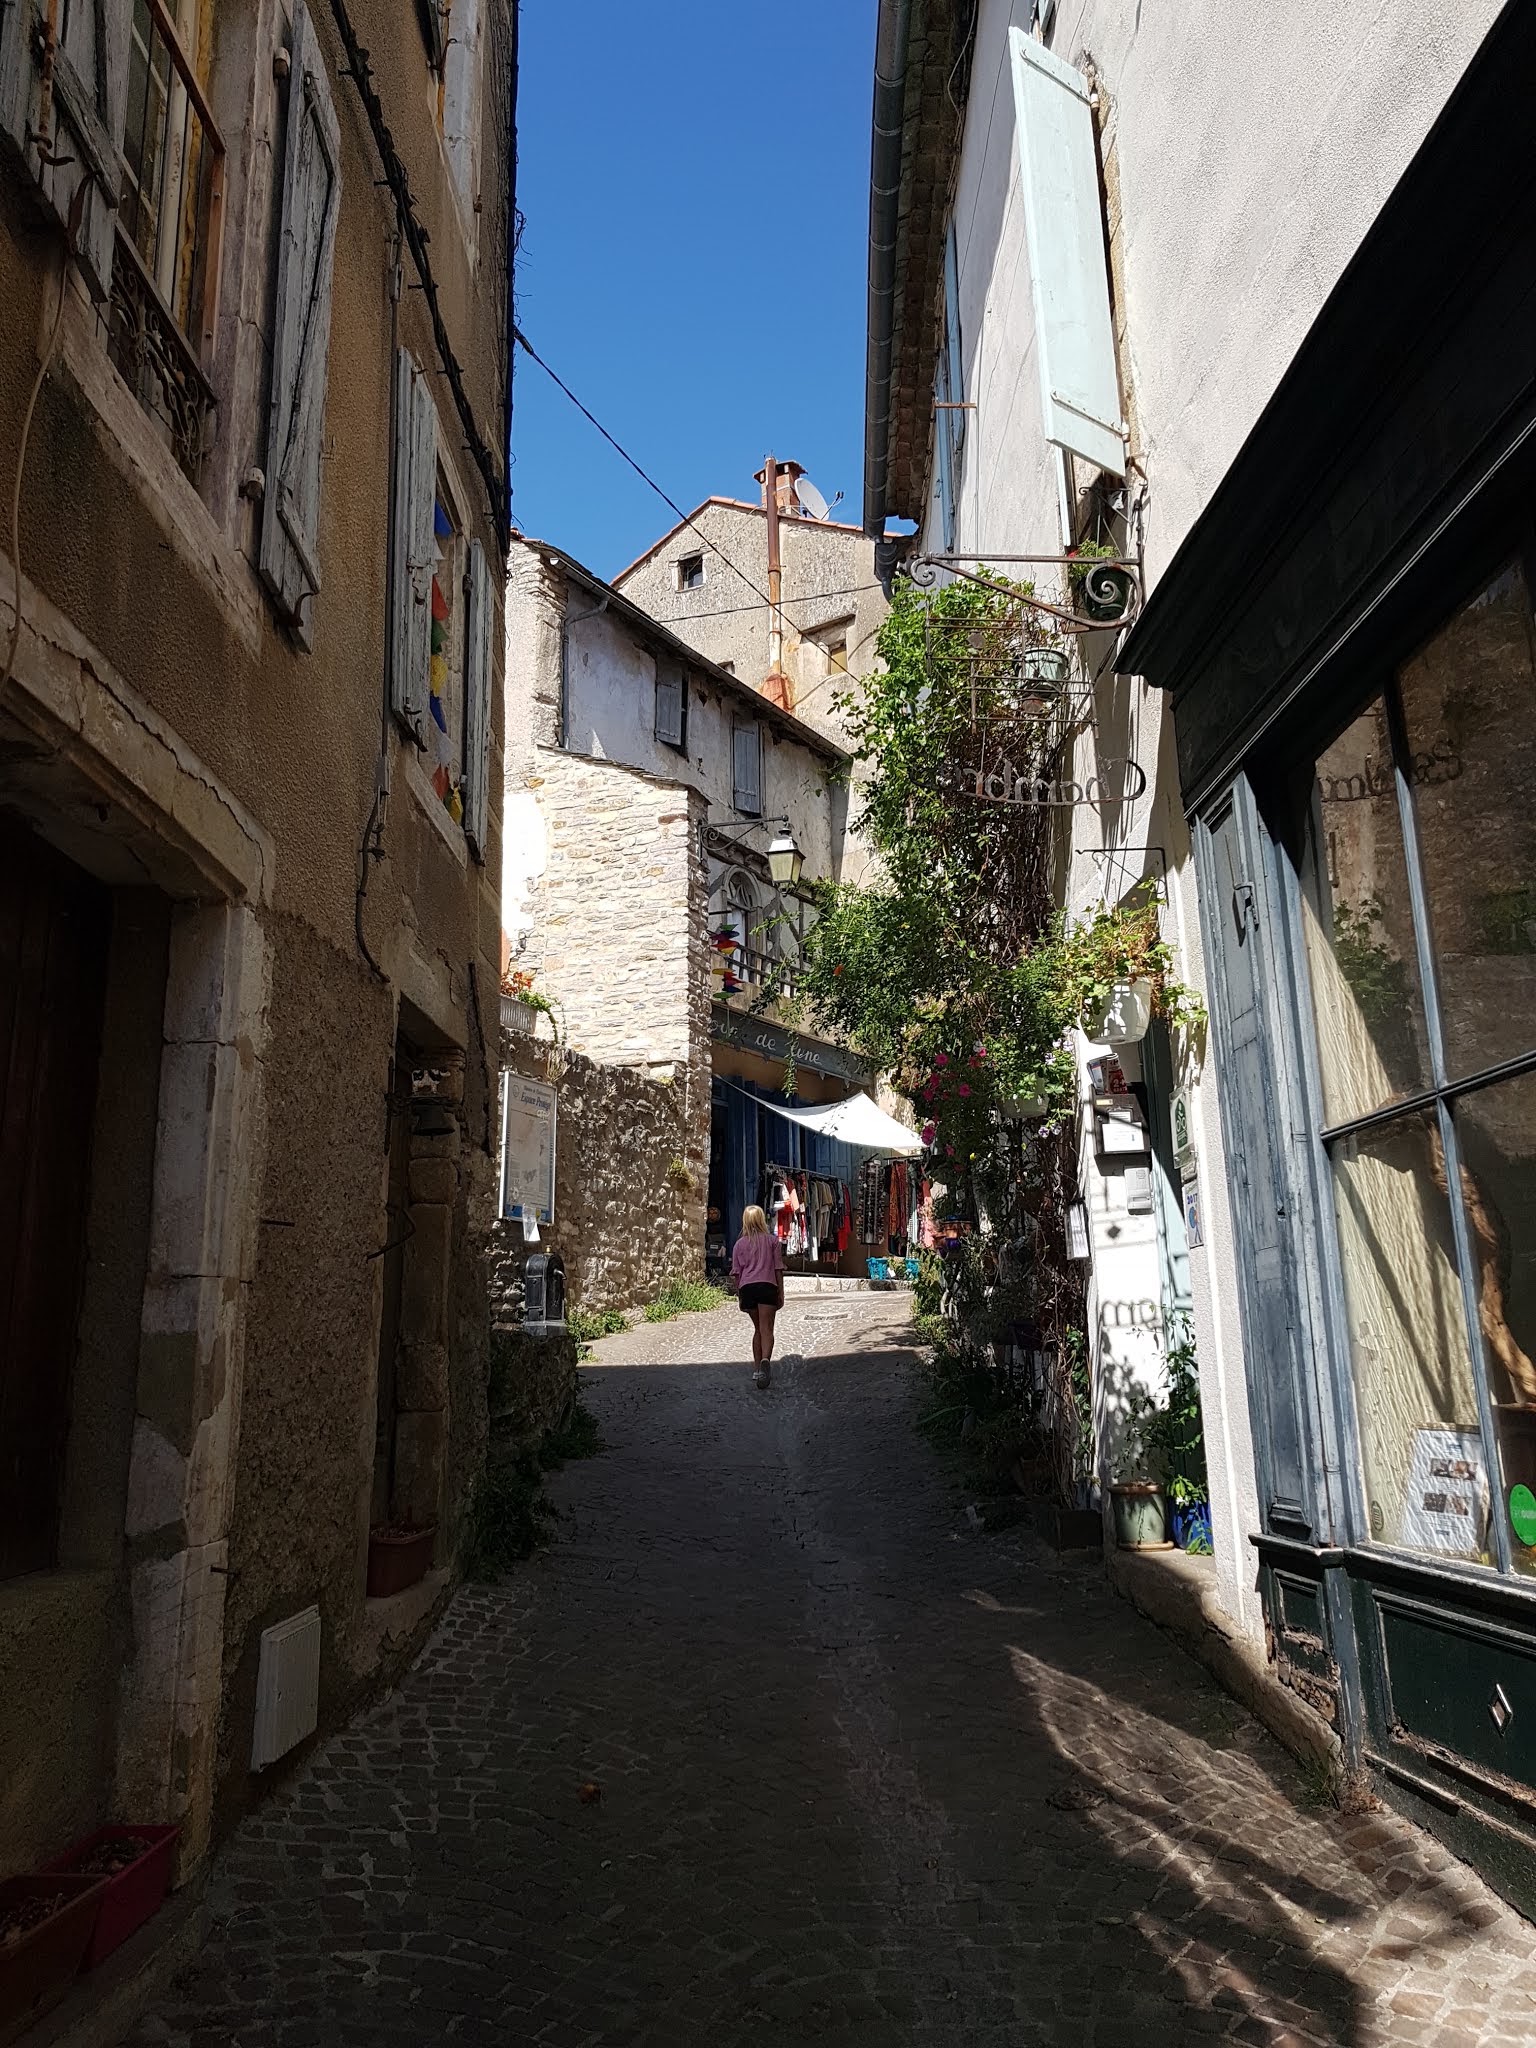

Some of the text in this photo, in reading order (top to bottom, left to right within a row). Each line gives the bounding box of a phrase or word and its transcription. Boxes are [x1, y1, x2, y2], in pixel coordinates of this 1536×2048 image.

[754, 1033, 777, 1052] de
[790, 1041, 823, 1066] lune
[1187, 1192, 1199, 1206] 2017
